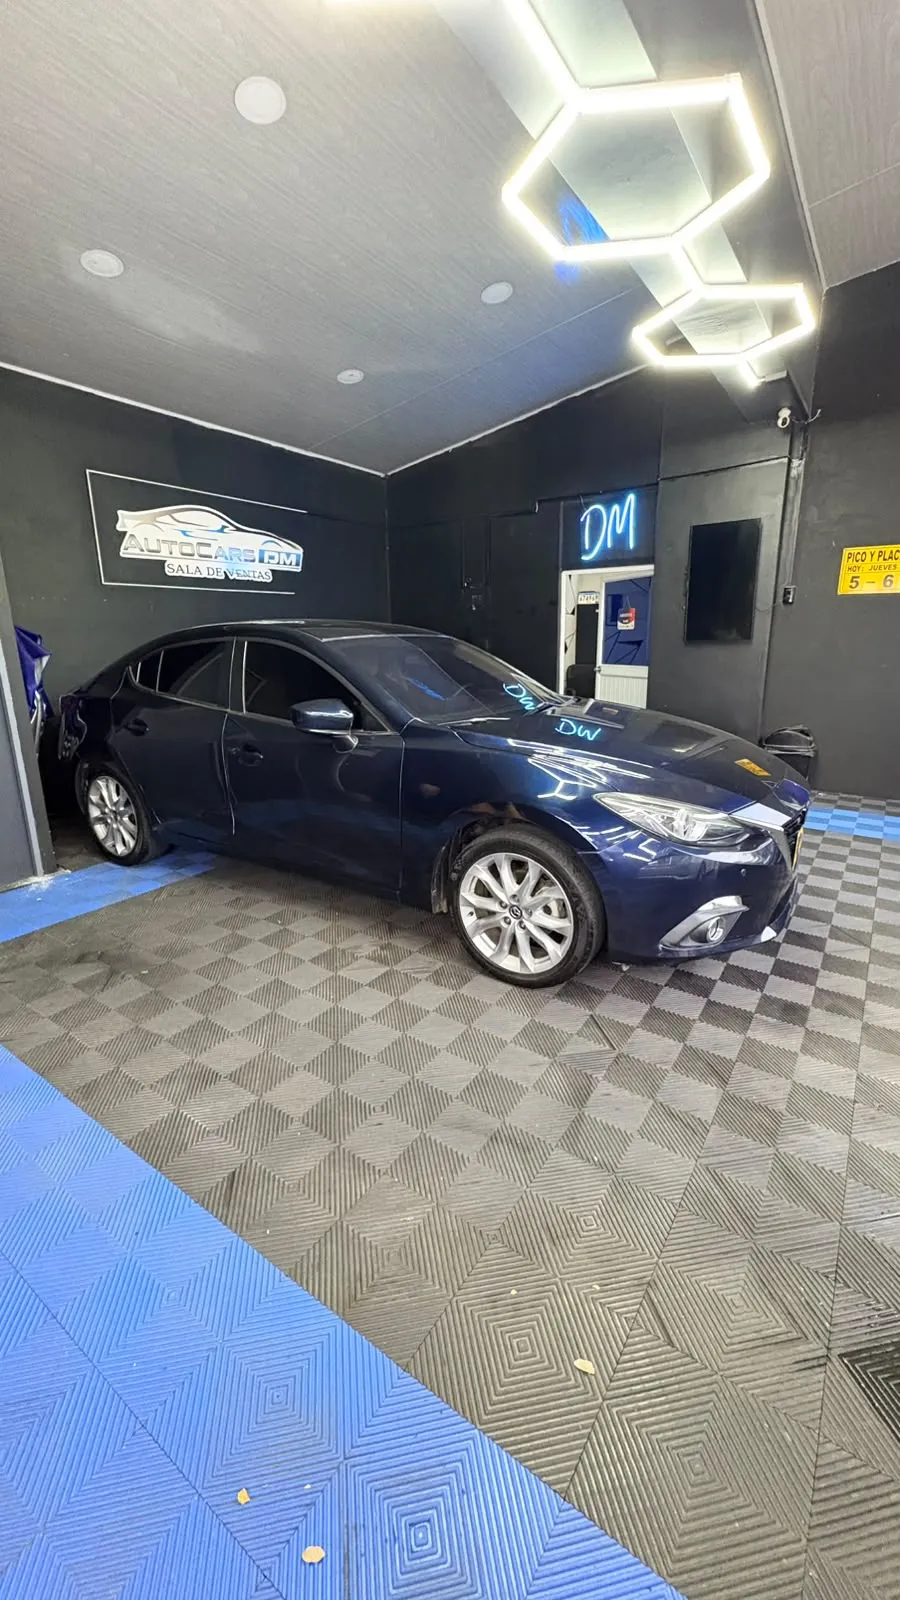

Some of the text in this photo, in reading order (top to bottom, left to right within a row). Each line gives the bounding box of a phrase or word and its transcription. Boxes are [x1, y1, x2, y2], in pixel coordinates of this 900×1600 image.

[579, 493, 635, 561] DM
[123, 534, 256, 562] AUTOCARS
[846, 551, 867, 563] PICO
[869, 550, 876, 562] Y
[166, 563, 272, 581] SALA DE VENTAS
[848, 575, 860, 590] 5
[882, 574, 895, 588] 6
